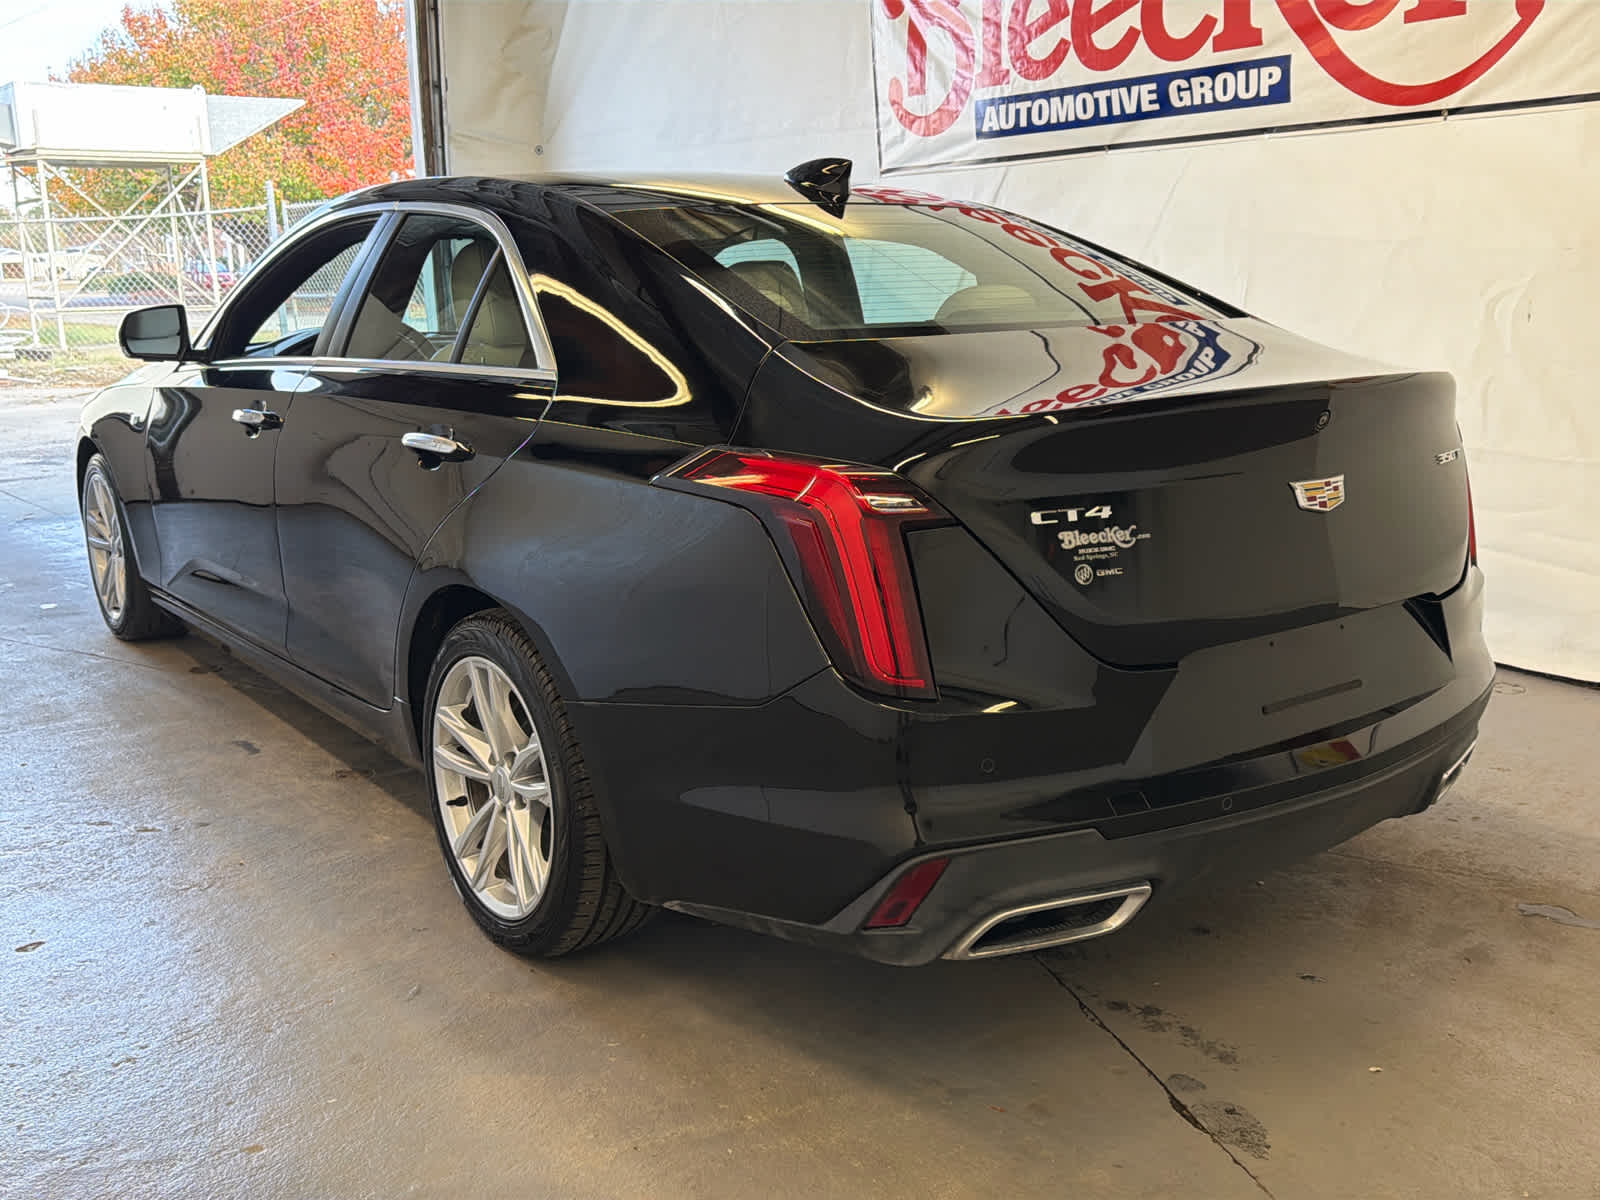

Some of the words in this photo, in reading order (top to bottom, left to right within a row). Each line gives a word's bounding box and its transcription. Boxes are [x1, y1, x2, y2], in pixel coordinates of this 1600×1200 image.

[982, 83, 1160, 132] AUTOMOTIVE
[1169, 66, 1282, 108] GROUP
[1030, 505, 1112, 525] CT4
[1096, 568, 1124, 577] GMC
